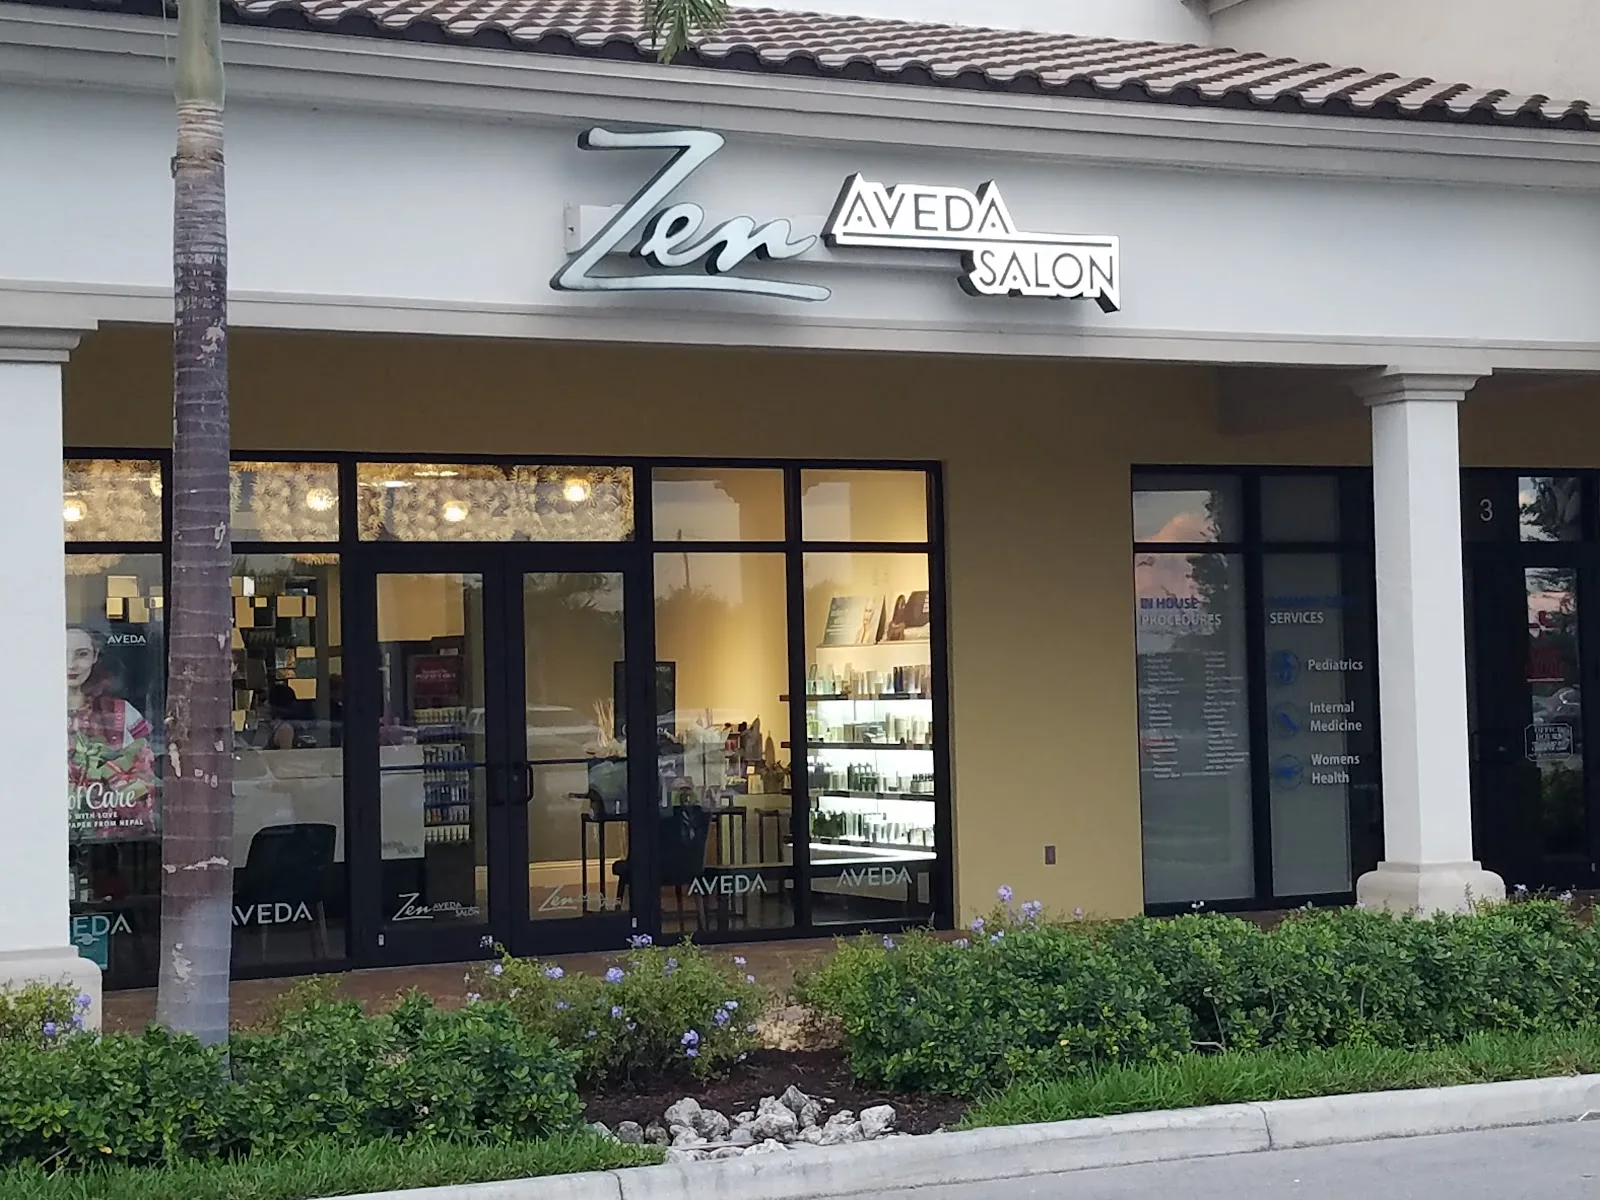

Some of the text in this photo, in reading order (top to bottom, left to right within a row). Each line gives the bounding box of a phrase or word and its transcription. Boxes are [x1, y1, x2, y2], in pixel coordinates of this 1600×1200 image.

[550, 127, 832, 302] Zen
[840, 191, 1013, 235] AVEDA
[978, 249, 1115, 291] SALON
[1479, 498, 1494, 522] 3
[1155, 597, 1199, 610] HOUSE
[1141, 612, 1222, 626] PROCEDURES
[1269, 611, 1324, 624] SERVICES
[107, 634, 147, 645] AVEDA
[1307, 658, 1364, 671] Pediatrics
[1309, 701, 1355, 714] Internal
[1309, 719, 1363, 732] Medicine
[1311, 753, 1361, 766] Womens
[1311, 771, 1350, 784] Health
[86, 782, 137, 810] Care
[74, 812, 95, 820] WITH
[97, 811, 118, 819] LOVE
[94, 820, 117, 828] FROM
[119, 818, 144, 827] NEPAL
[837, 865, 913, 888] AVEDA
[687, 873, 768, 897] AVEDA
[391, 892, 434, 921] Zen
[432, 901, 463, 911] AVEDA
[72, 913, 133, 936] EDA
